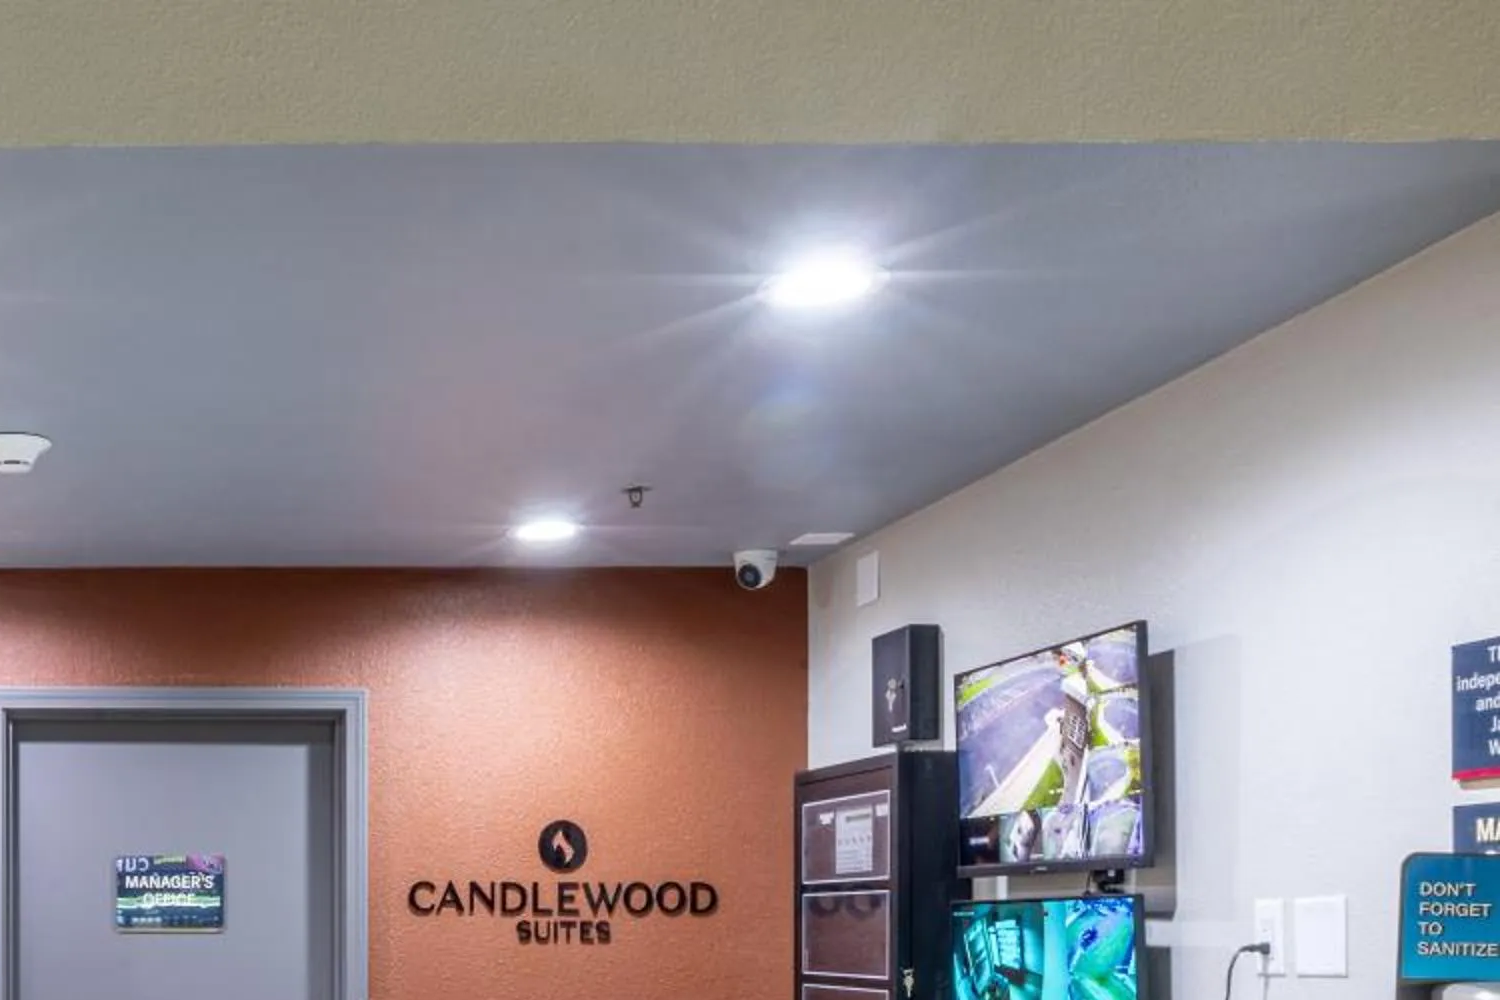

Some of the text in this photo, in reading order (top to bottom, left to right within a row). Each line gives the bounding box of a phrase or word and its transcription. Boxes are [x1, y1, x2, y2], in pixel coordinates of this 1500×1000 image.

[124, 874, 214, 889] MANAGER'S
[1419, 881, 1476, 897] DON'T
[407, 880, 719, 917] CANDLEWOOD
[1419, 901, 1492, 917] FORGET
[516, 919, 611, 944] SUITES
[1417, 921, 1442, 936] TO
[1417, 941, 1499, 957] SANITIZE
